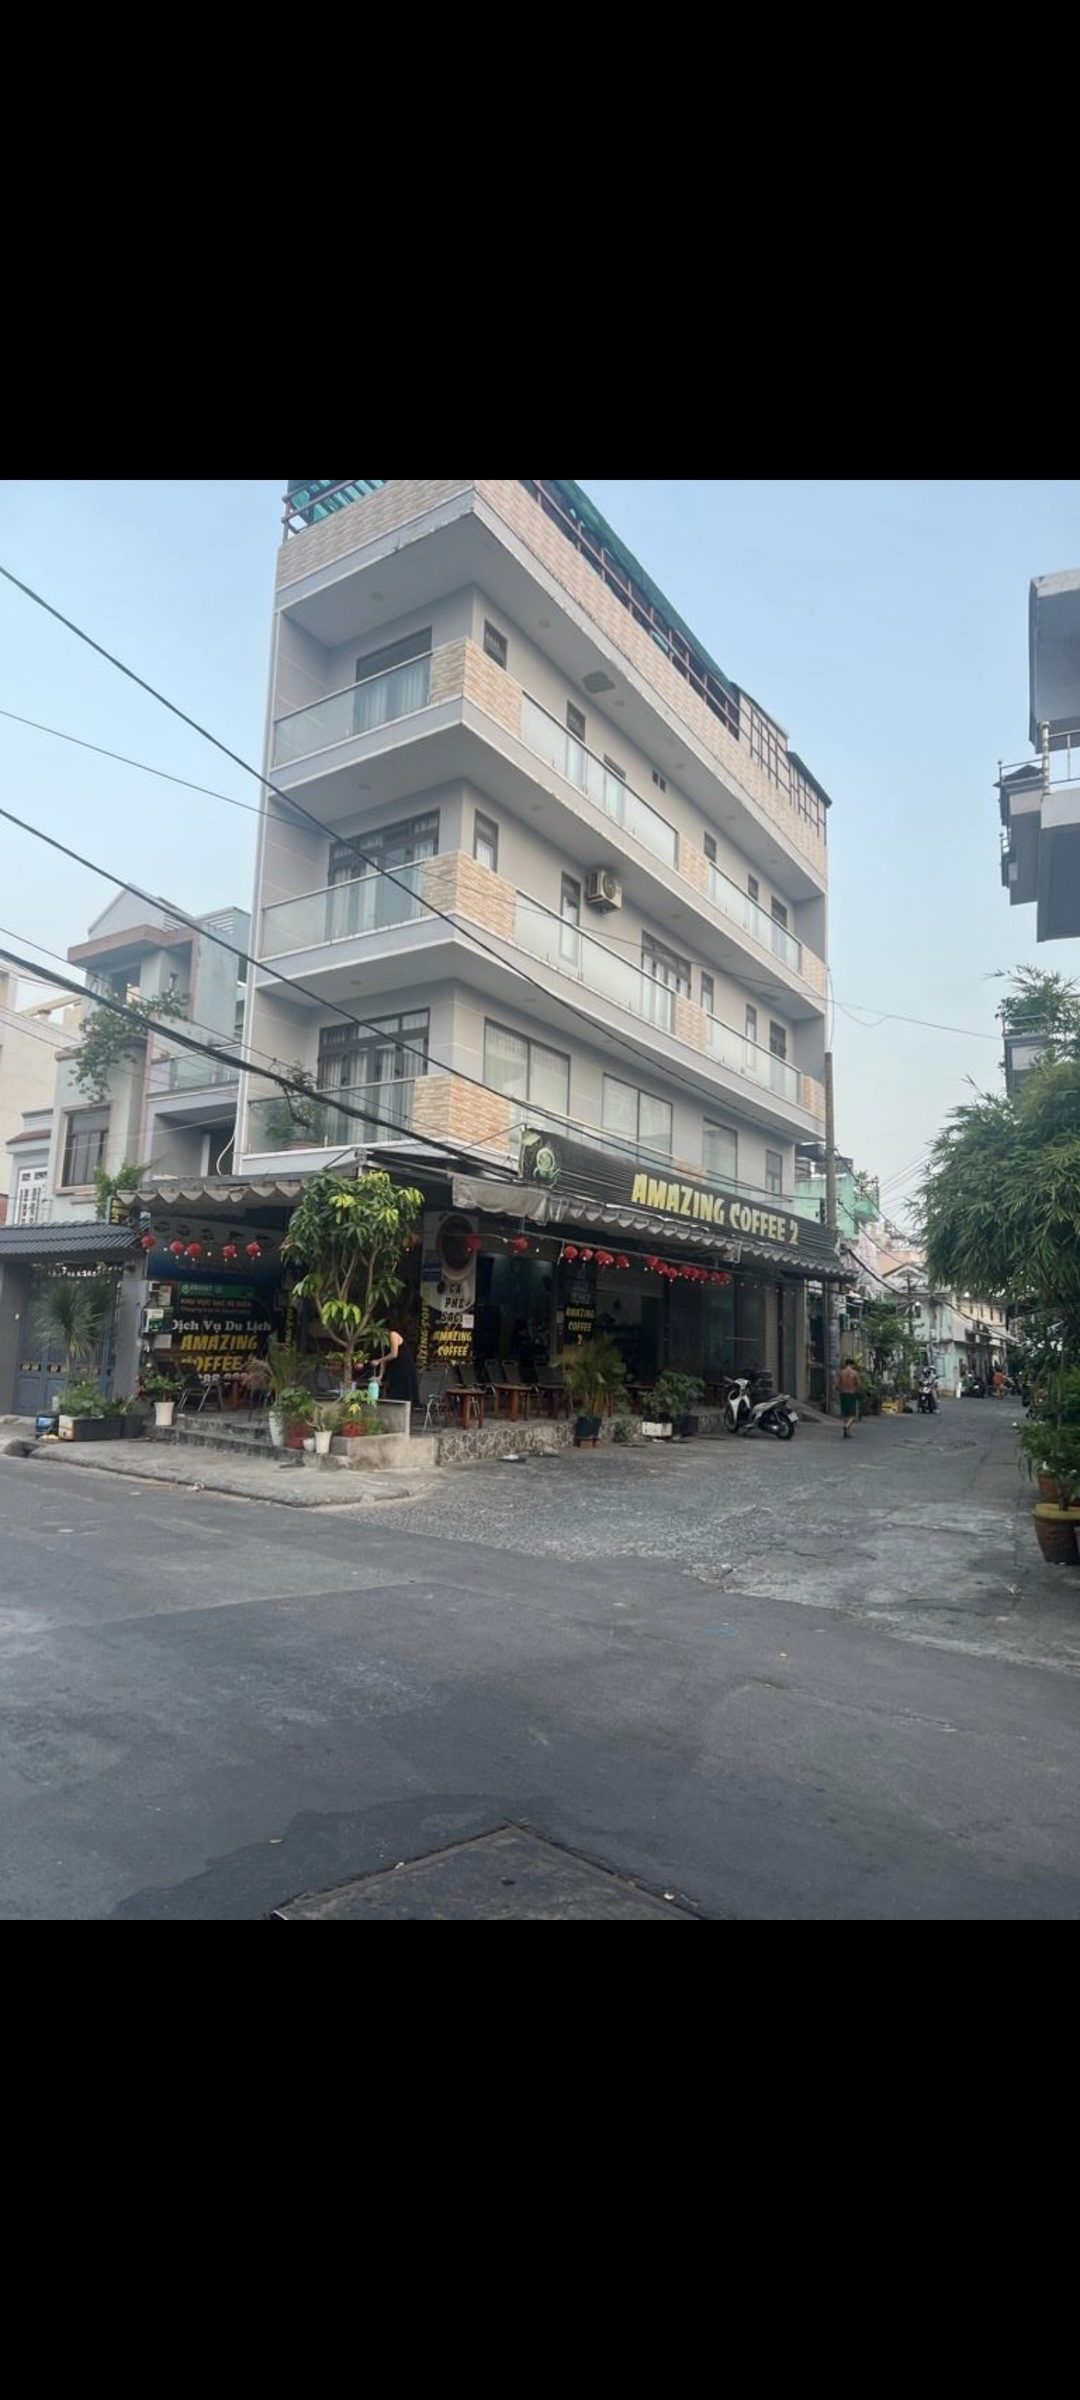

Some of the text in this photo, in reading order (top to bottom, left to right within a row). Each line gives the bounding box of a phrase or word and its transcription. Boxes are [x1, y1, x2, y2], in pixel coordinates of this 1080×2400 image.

[630, 1173, 799, 1245] AMAZING COFFEE 2
[202, 1320, 222, 1333] Vụ
[224, 1320, 243, 1331] Du
[246, 1320, 271, 1333] Lịch
[181, 1334, 258, 1351] AMAZING
[437, 1345, 468, 1357] COFFEE
